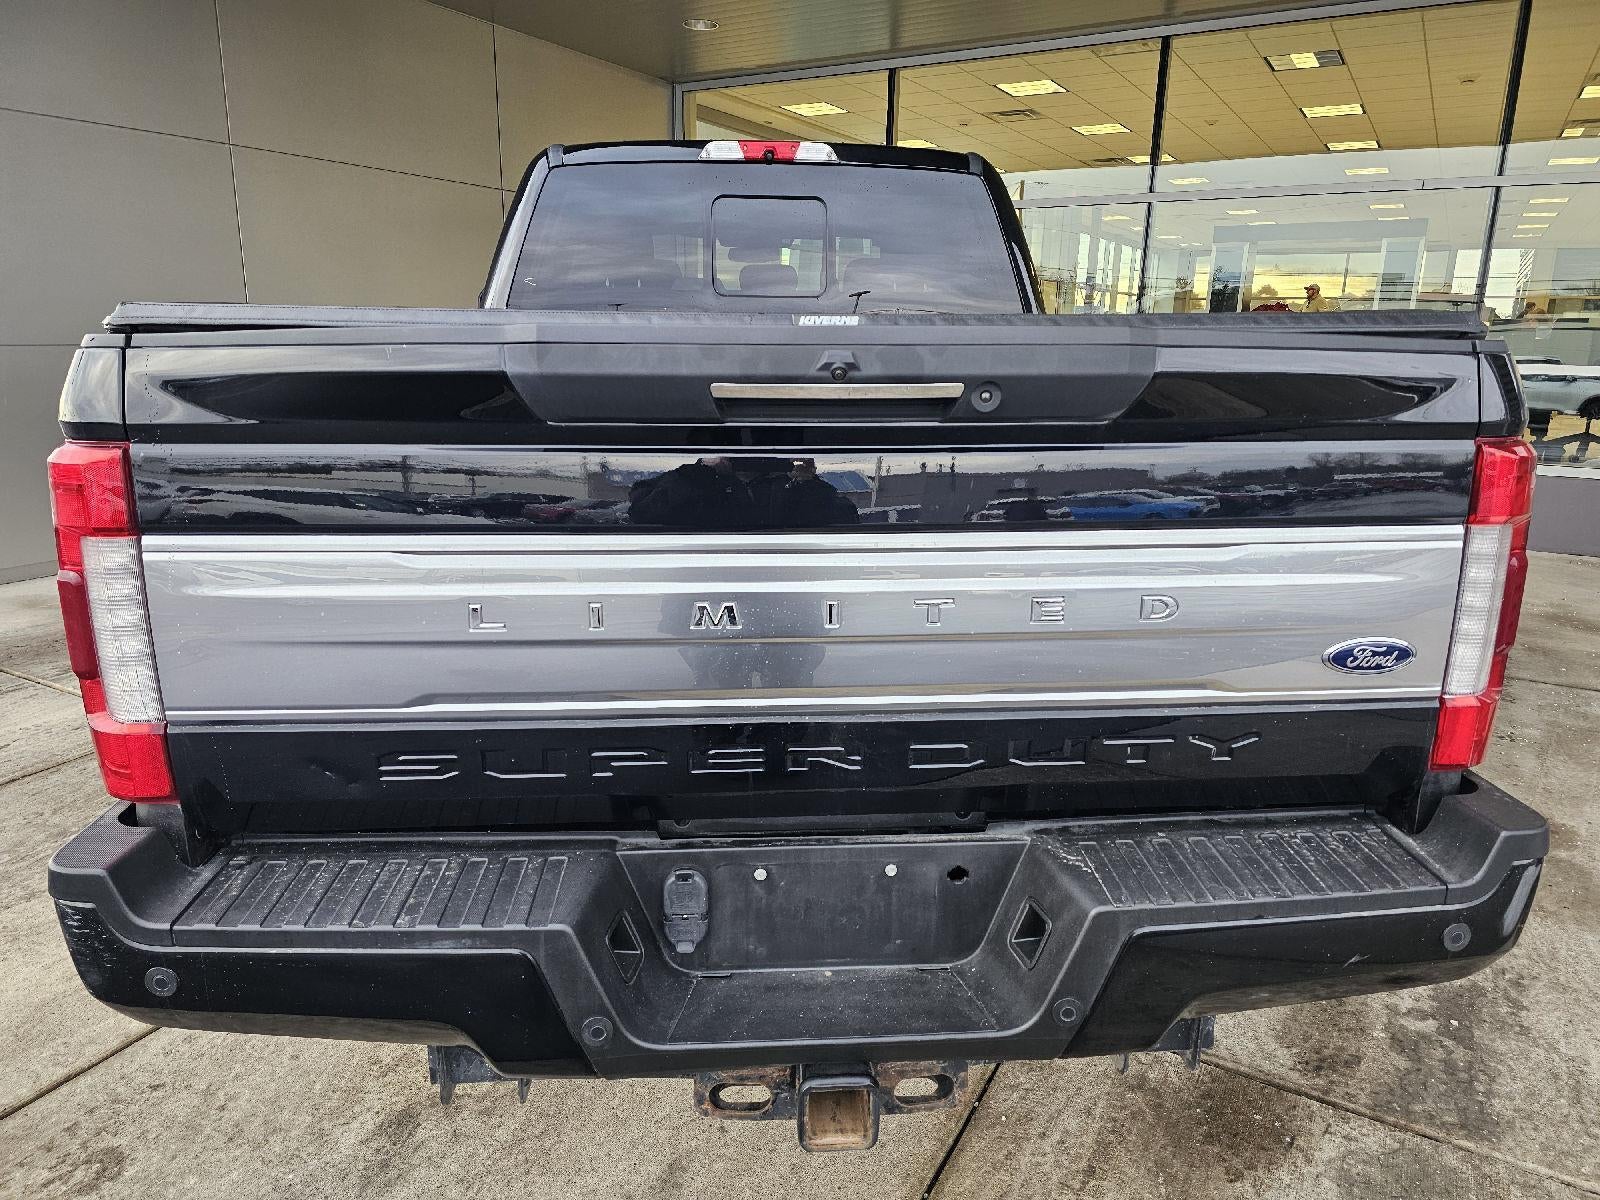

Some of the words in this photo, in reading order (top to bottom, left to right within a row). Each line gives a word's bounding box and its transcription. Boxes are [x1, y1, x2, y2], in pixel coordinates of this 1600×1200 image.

[467, 594, 1180, 633] LIMITED
[1347, 645, 1399, 668] Ford
[377, 742, 864, 782] SUPER
[907, 731, 1262, 770] DUTY
